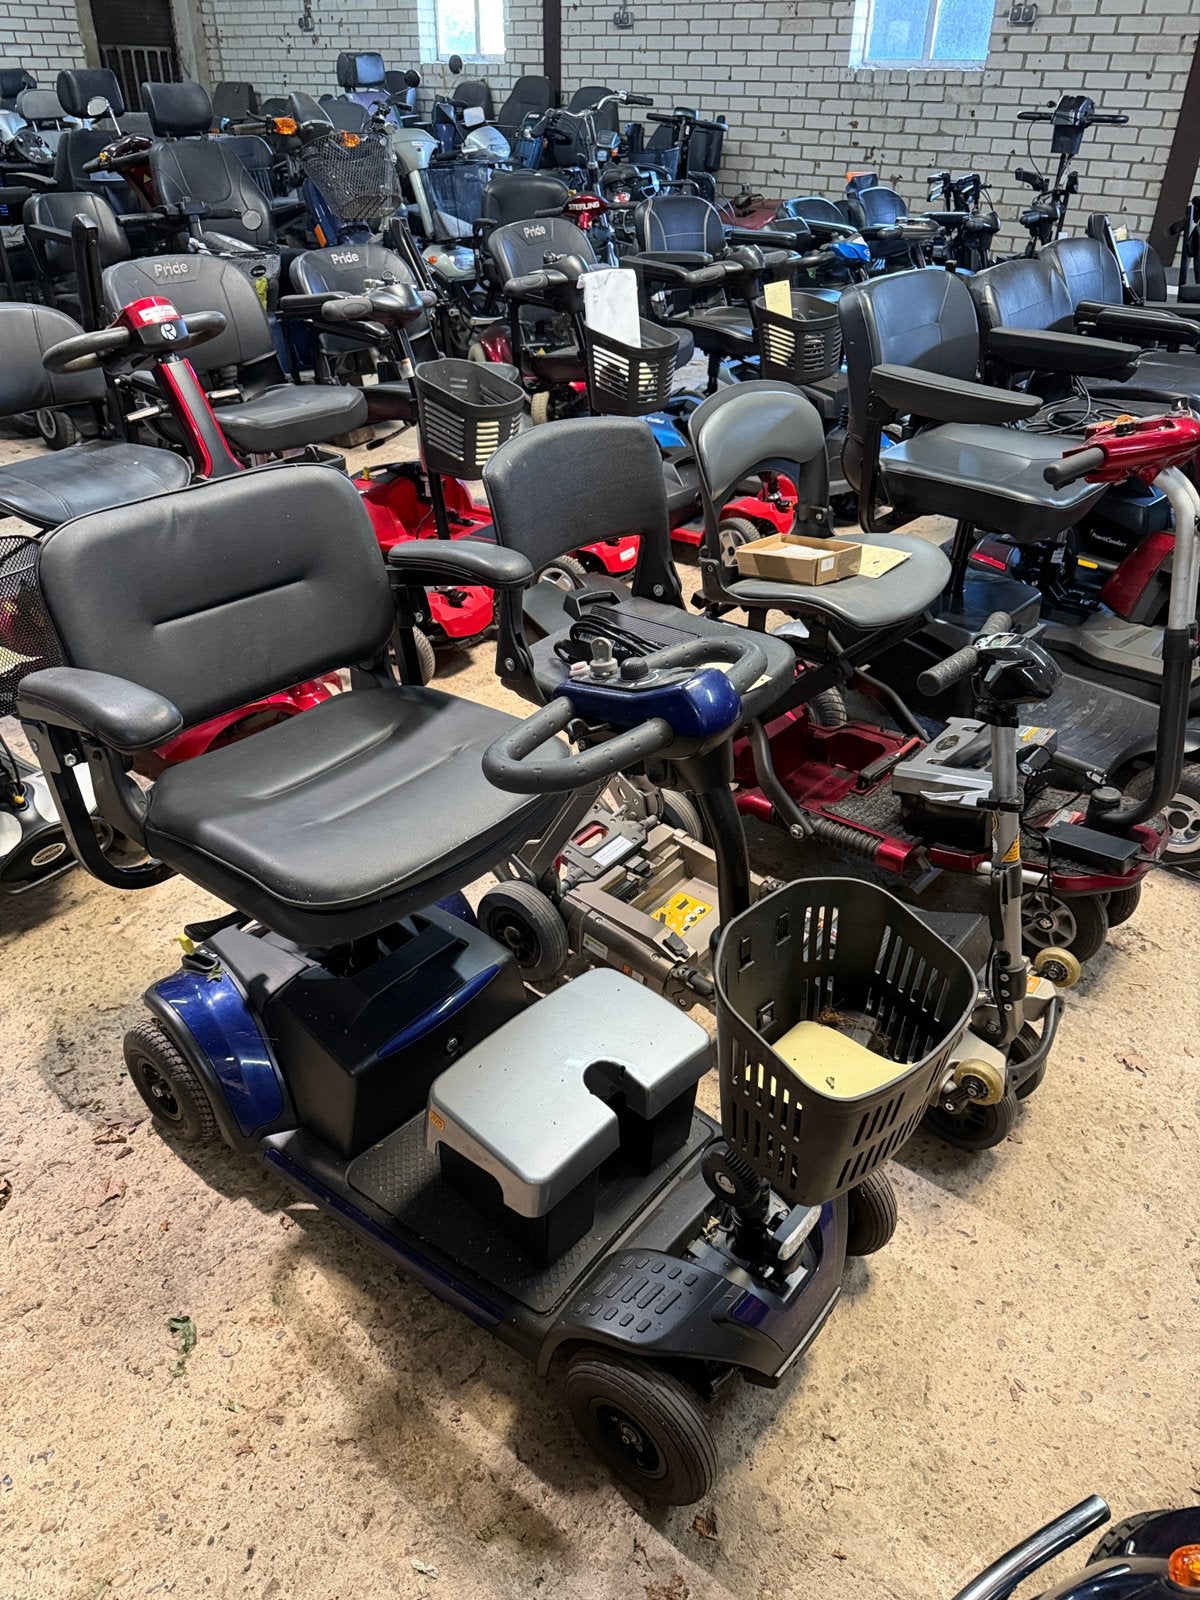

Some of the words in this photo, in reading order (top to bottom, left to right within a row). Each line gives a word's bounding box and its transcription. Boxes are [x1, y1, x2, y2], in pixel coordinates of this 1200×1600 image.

[567, 201, 601, 211] STERLING
[523, 224, 547, 239] Pride
[330, 251, 360, 265] Pride
[153, 261, 189, 277] Pride
